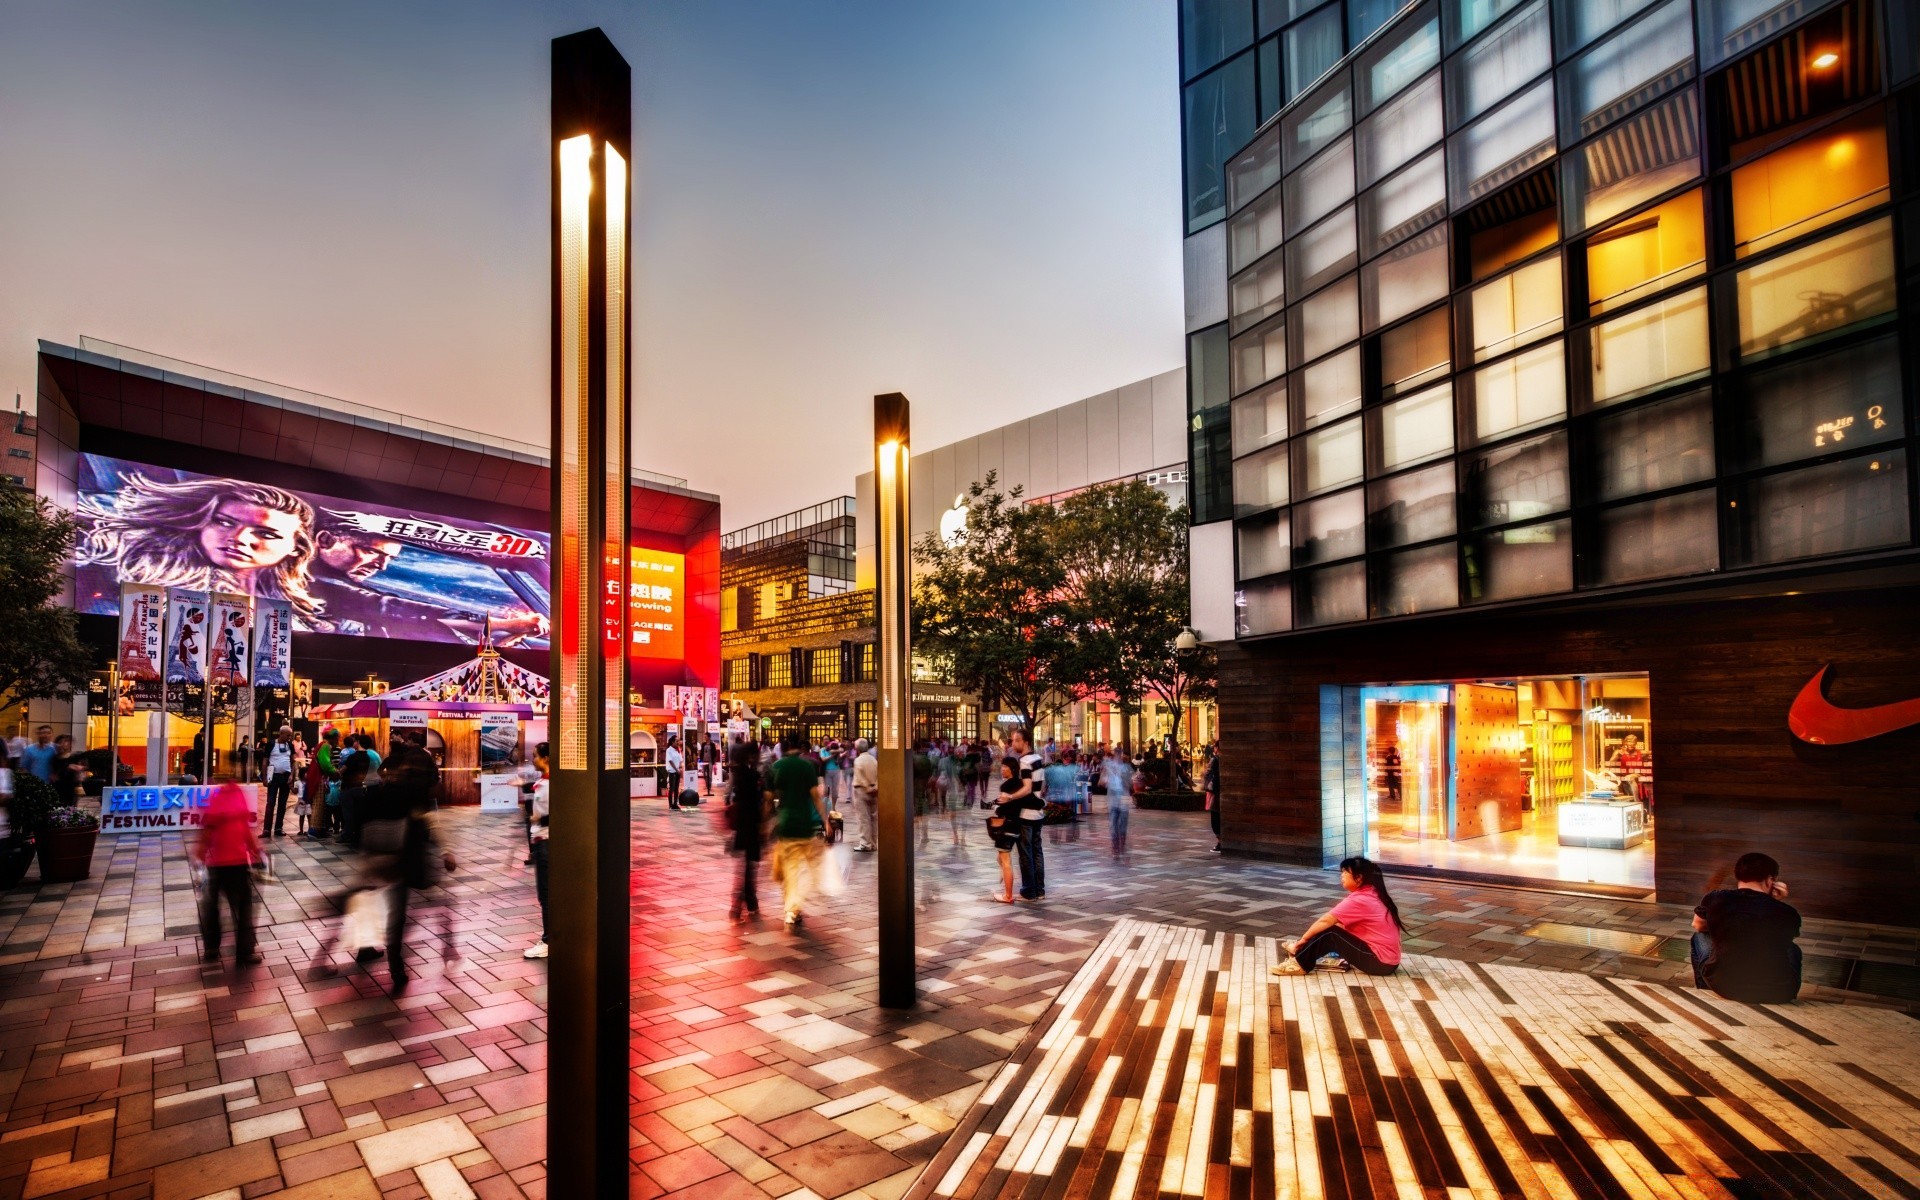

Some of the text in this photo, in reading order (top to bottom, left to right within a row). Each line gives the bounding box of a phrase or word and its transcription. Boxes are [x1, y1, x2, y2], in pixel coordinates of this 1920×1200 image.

[630, 602, 672, 613] owing
[437, 711, 465, 719] FESTIVAL
[110, 787, 220, 813] 法国文化
[102, 814, 176, 829] FESTIVAL
